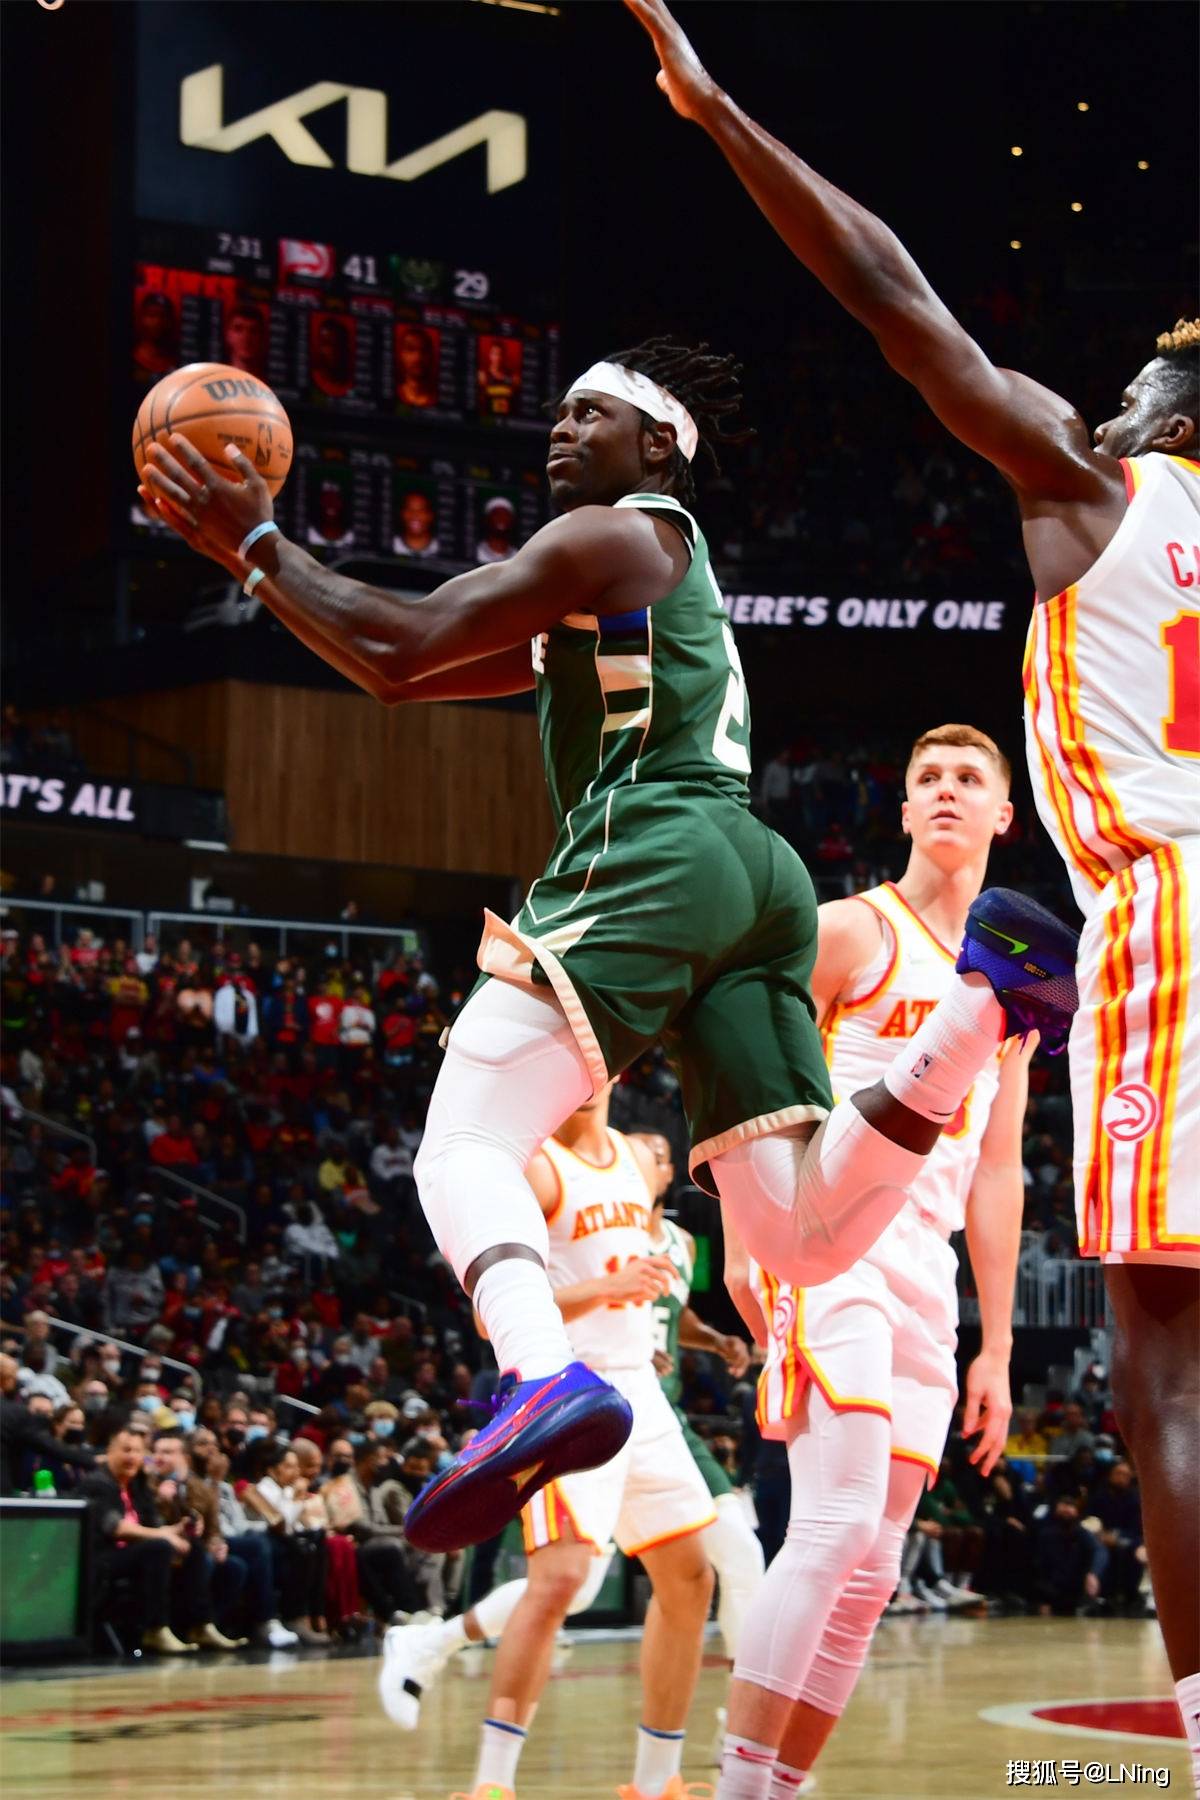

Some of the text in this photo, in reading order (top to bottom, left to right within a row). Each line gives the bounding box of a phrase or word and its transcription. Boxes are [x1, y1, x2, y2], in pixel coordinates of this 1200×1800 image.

[342, 255, 378, 284] 41
[453, 269, 490, 300] 29
[836, 598, 927, 629] ONLY
[932, 601, 1005, 630] ONE
[69, 782, 136, 821] ALL
